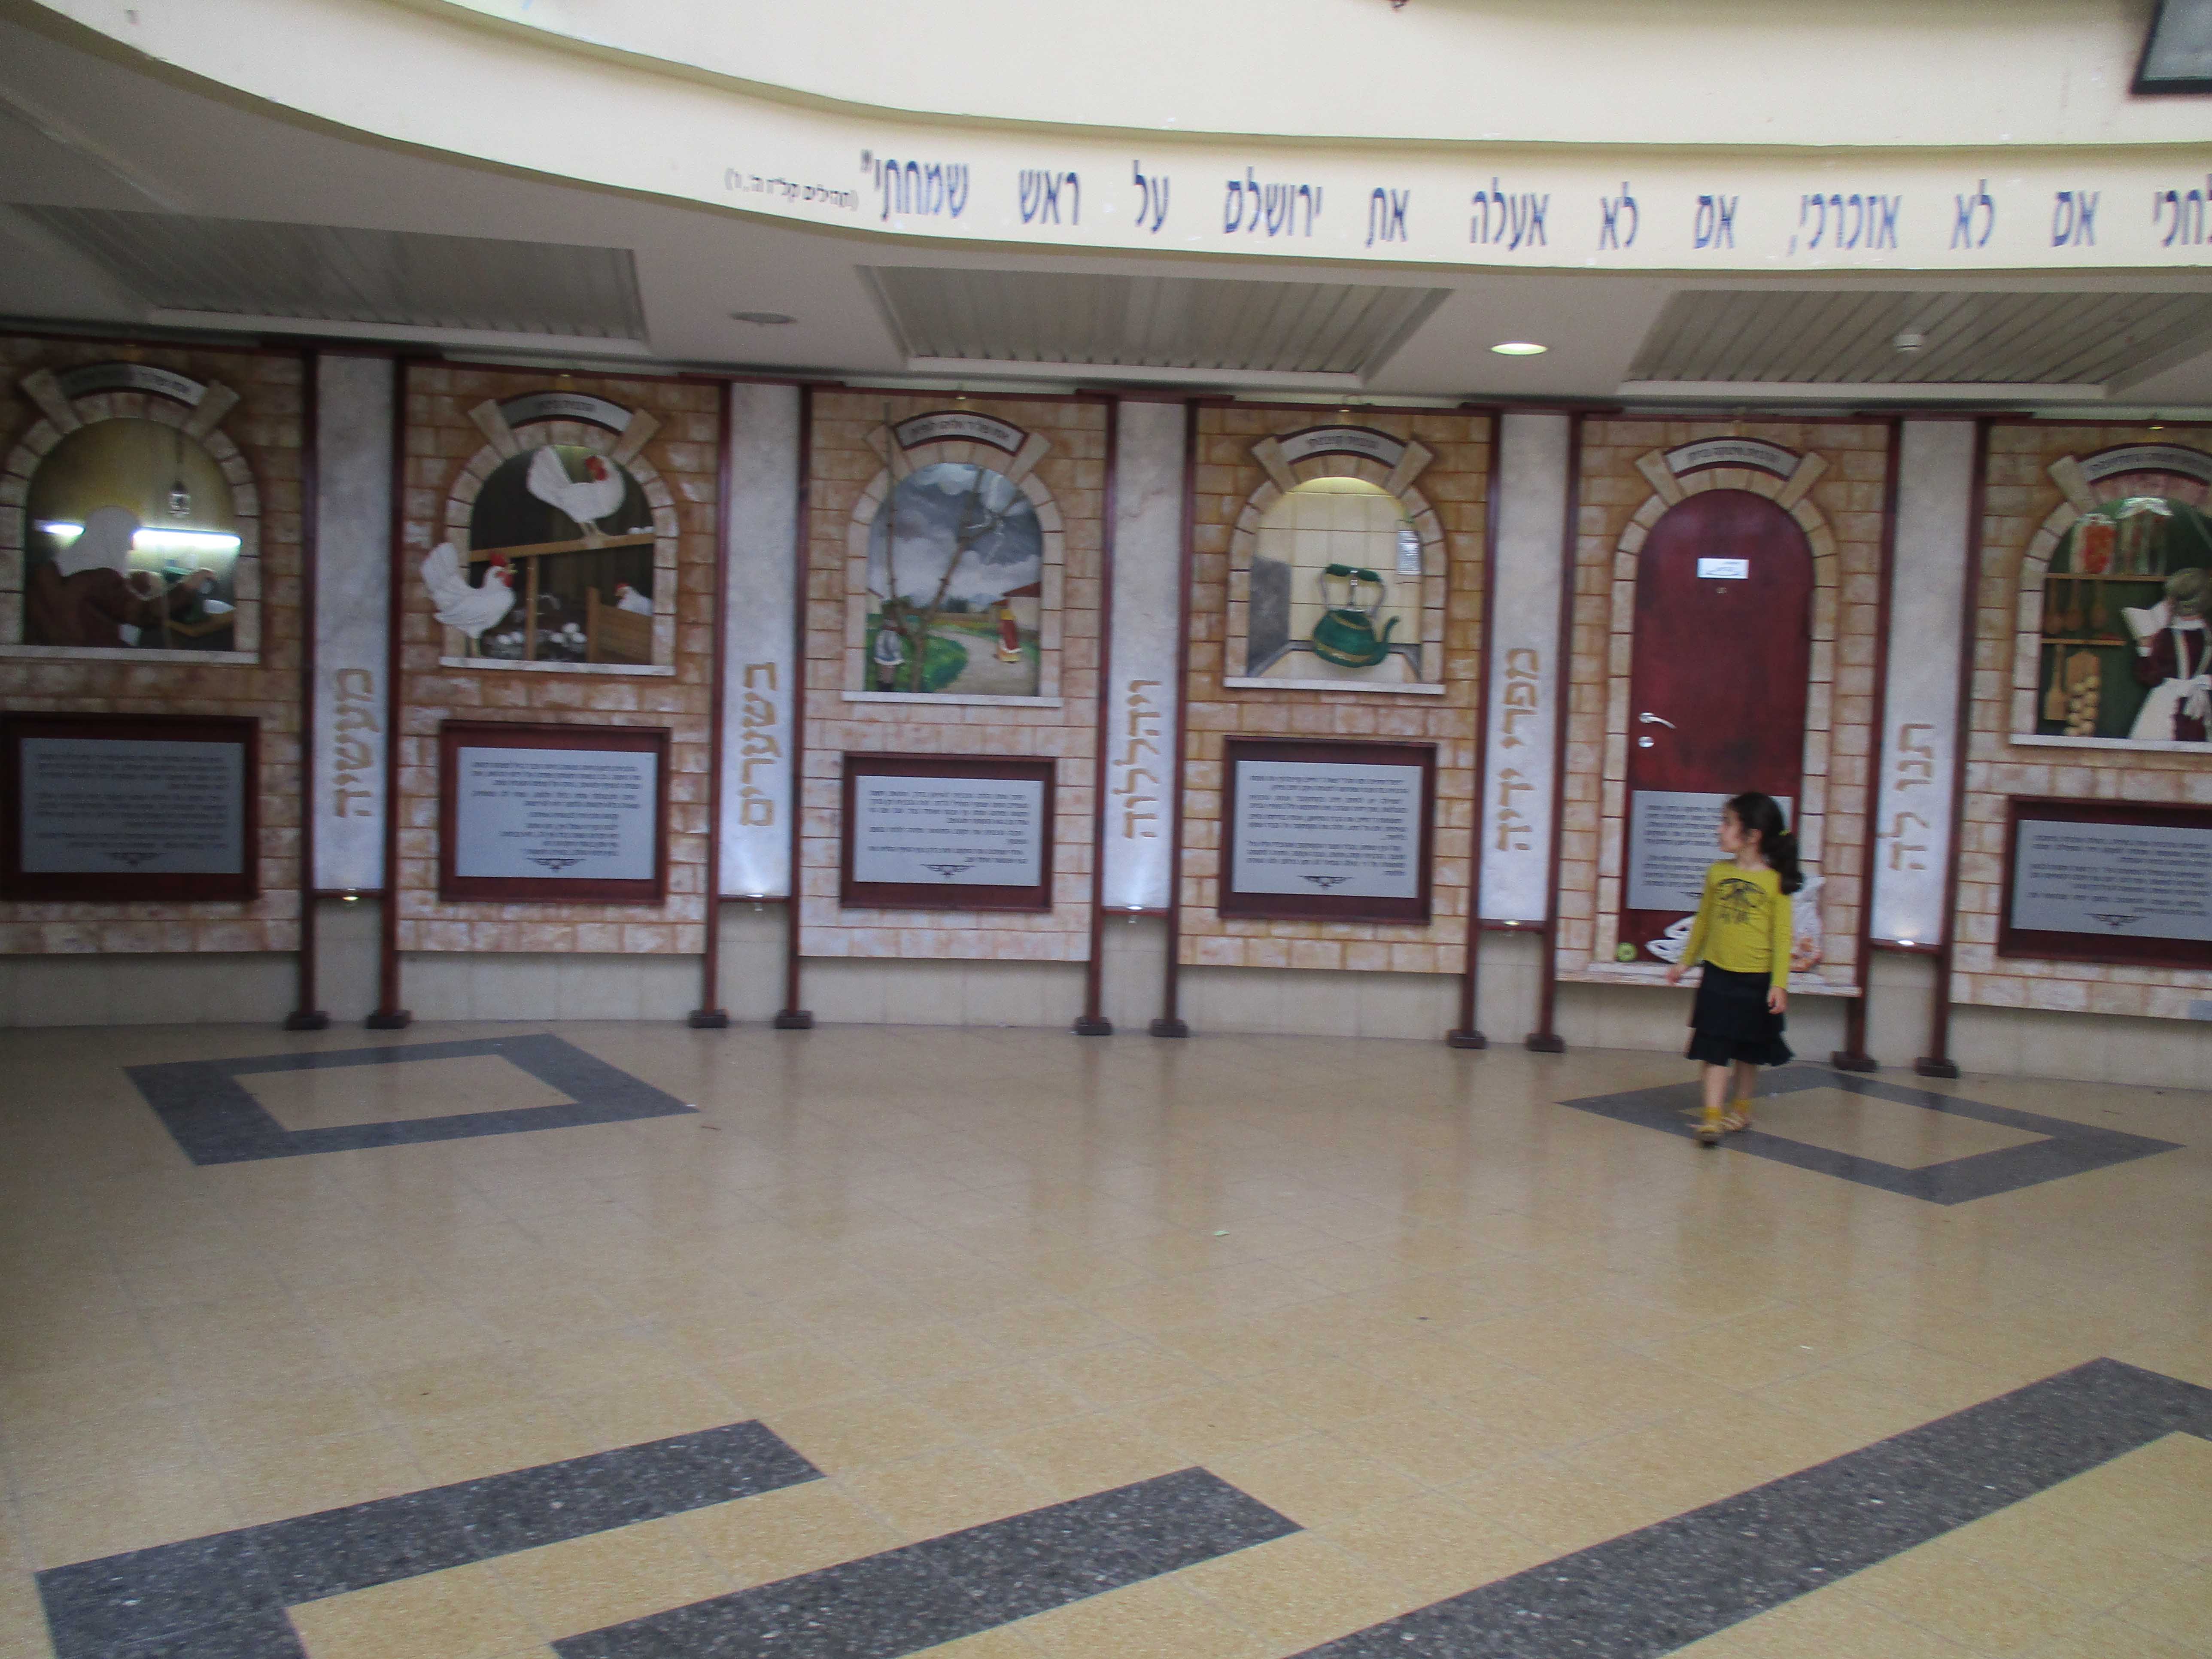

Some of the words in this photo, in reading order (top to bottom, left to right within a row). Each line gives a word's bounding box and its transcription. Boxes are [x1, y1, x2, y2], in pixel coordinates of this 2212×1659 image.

[1019, 170, 1080, 226] ראש
[1133, 159, 1169, 234] על
[1223, 166, 1323, 237] ירושלם
[1364, 187, 1410, 248] את
[1469, 176, 1551, 251] אעלה
[1598, 181, 1639, 251] לא
[1693, 194, 1739, 250] אם
[1948, 178, 1994, 249] לא
[2050, 191, 2100, 247] אם
[2153, 173, 2212, 248] חכי
[1501, 647, 1540, 750] מפרי
[332, 668, 380, 818] מעשיה
[741, 662, 782, 827] בשערים
[1113, 679, 1162, 840] ויהללוה
[1894, 723, 1934, 791] תנו
[1495, 766, 1535, 852] ידיה
[1875, 811, 1930, 871] לה
